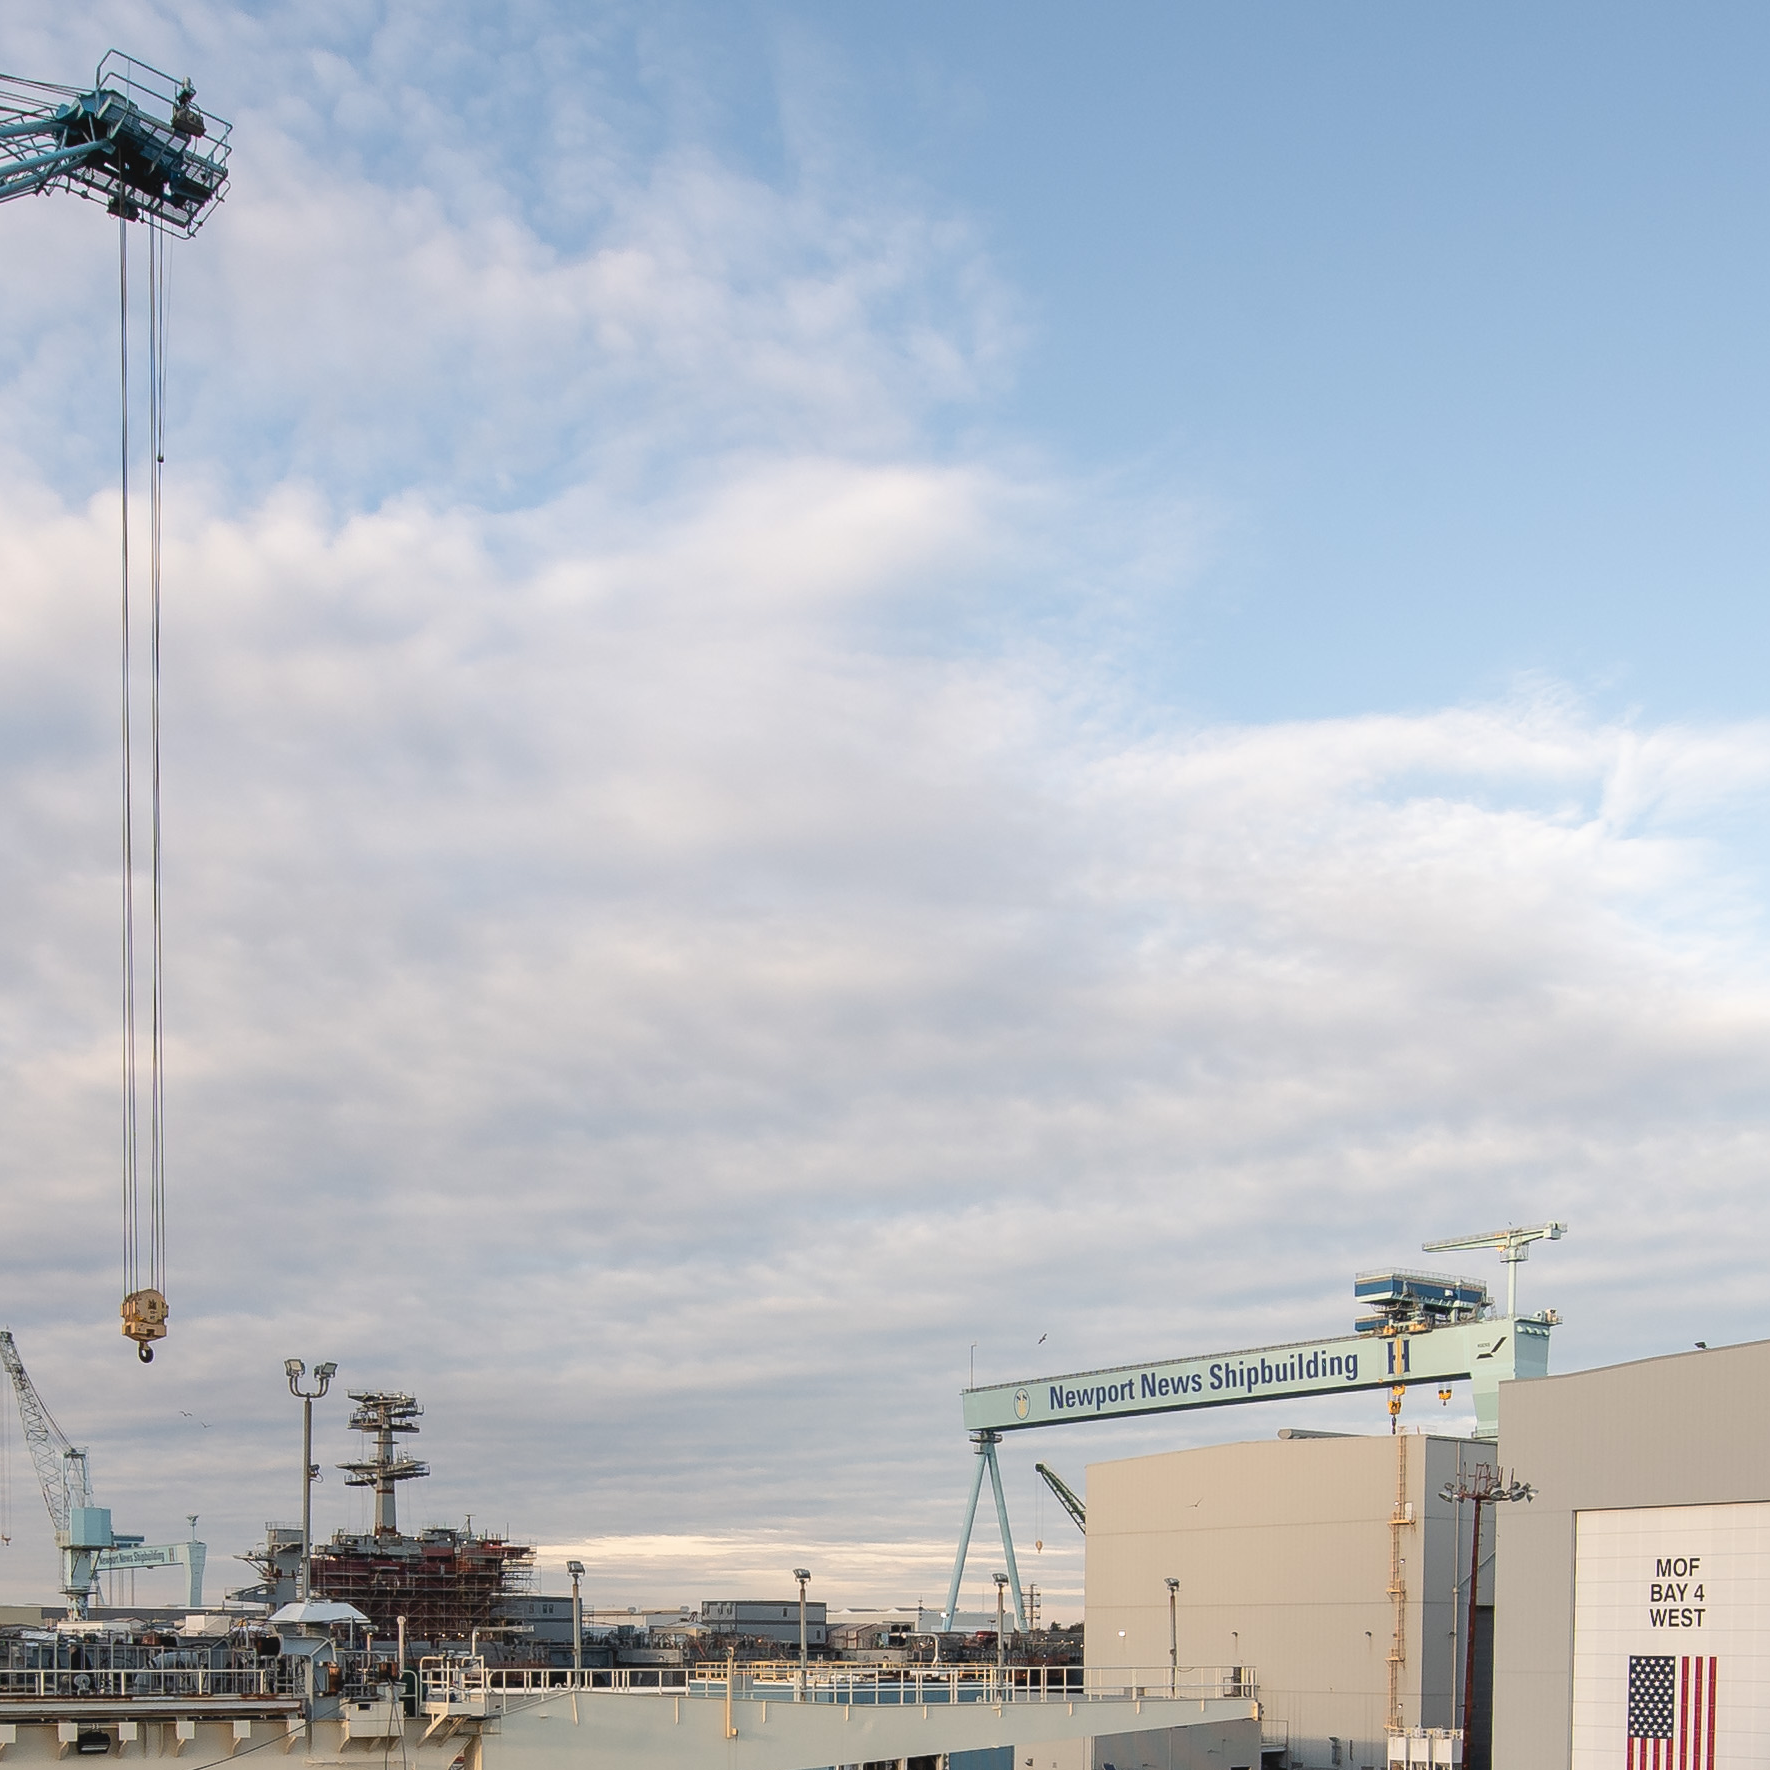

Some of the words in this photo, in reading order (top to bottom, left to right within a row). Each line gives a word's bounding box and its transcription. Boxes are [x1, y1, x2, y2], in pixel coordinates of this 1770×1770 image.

[1049, 1378, 1136, 1412] Newport
[1140, 1372, 1203, 1399] News
[1209, 1351, 1359, 1394] Shipbuilding
[1656, 1557, 1701, 1578] MOF
[1650, 1583, 1689, 1603] BAY
[1693, 1583, 1705, 1602] 4
[1649, 1607, 1706, 1628] WEST
